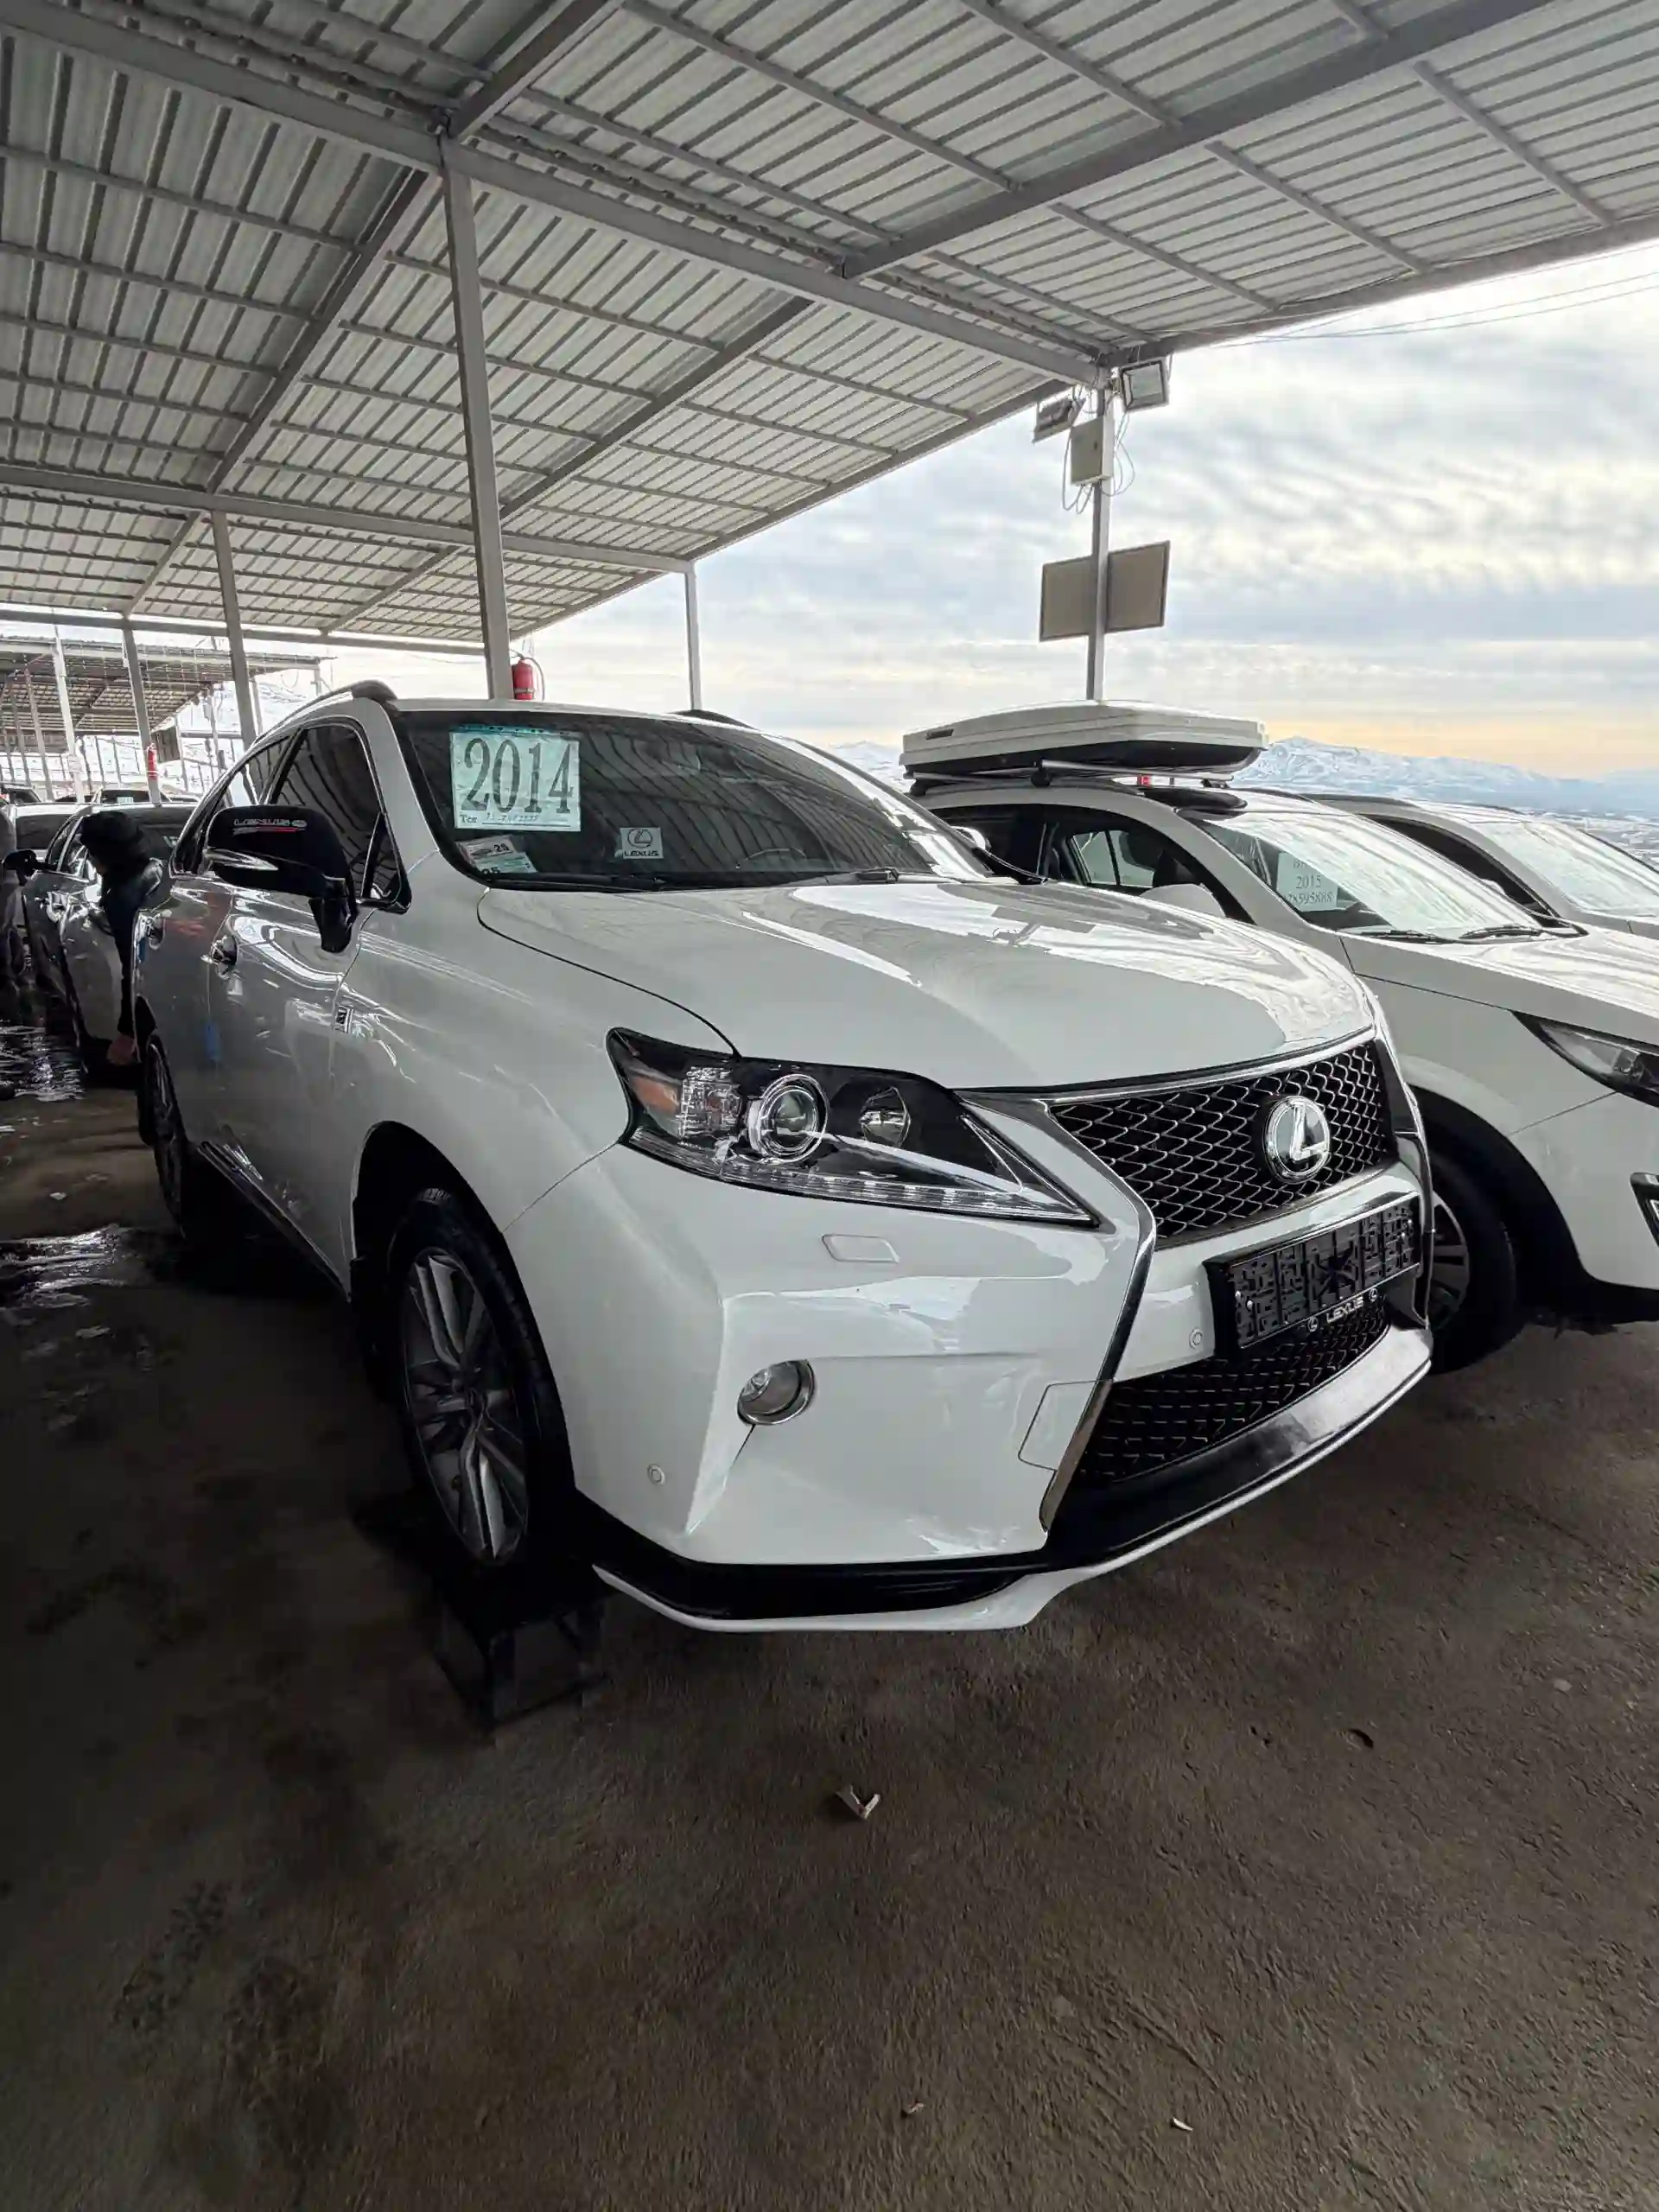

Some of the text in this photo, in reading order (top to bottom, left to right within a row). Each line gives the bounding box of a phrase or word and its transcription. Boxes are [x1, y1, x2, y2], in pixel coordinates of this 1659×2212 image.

[461, 737, 574, 813] 2014
[1296, 874, 1321, 889] 2015
[1326, 1295, 1363, 1323] LEXUS
